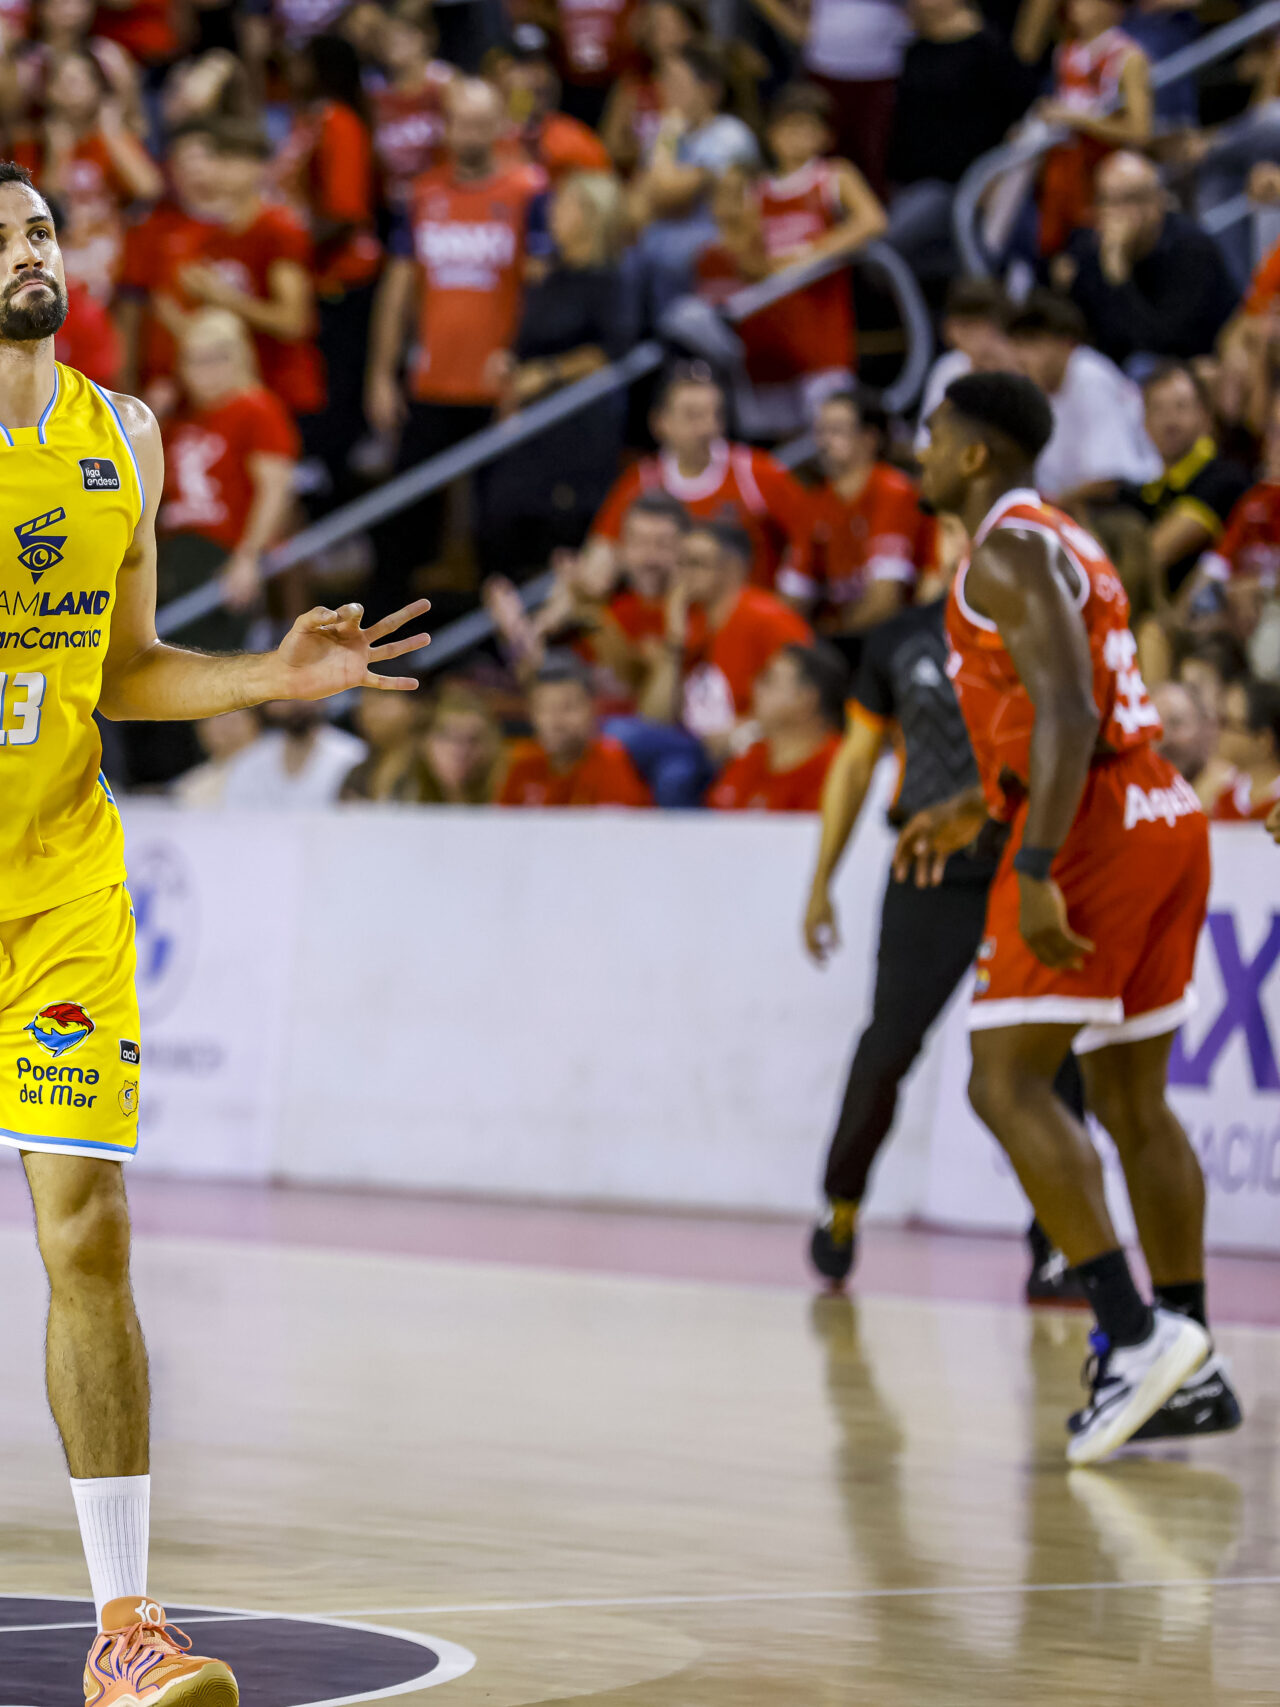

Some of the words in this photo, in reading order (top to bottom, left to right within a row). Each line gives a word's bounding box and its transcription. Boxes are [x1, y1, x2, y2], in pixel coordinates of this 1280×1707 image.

[85, 465, 100, 478] liga
[87, 477, 118, 486] endesa
[122, 1049, 136, 1062] acb
[16, 1057, 100, 1085] Poema
[19, 1083, 44, 1105] del
[50, 1085, 98, 1108] Mar
